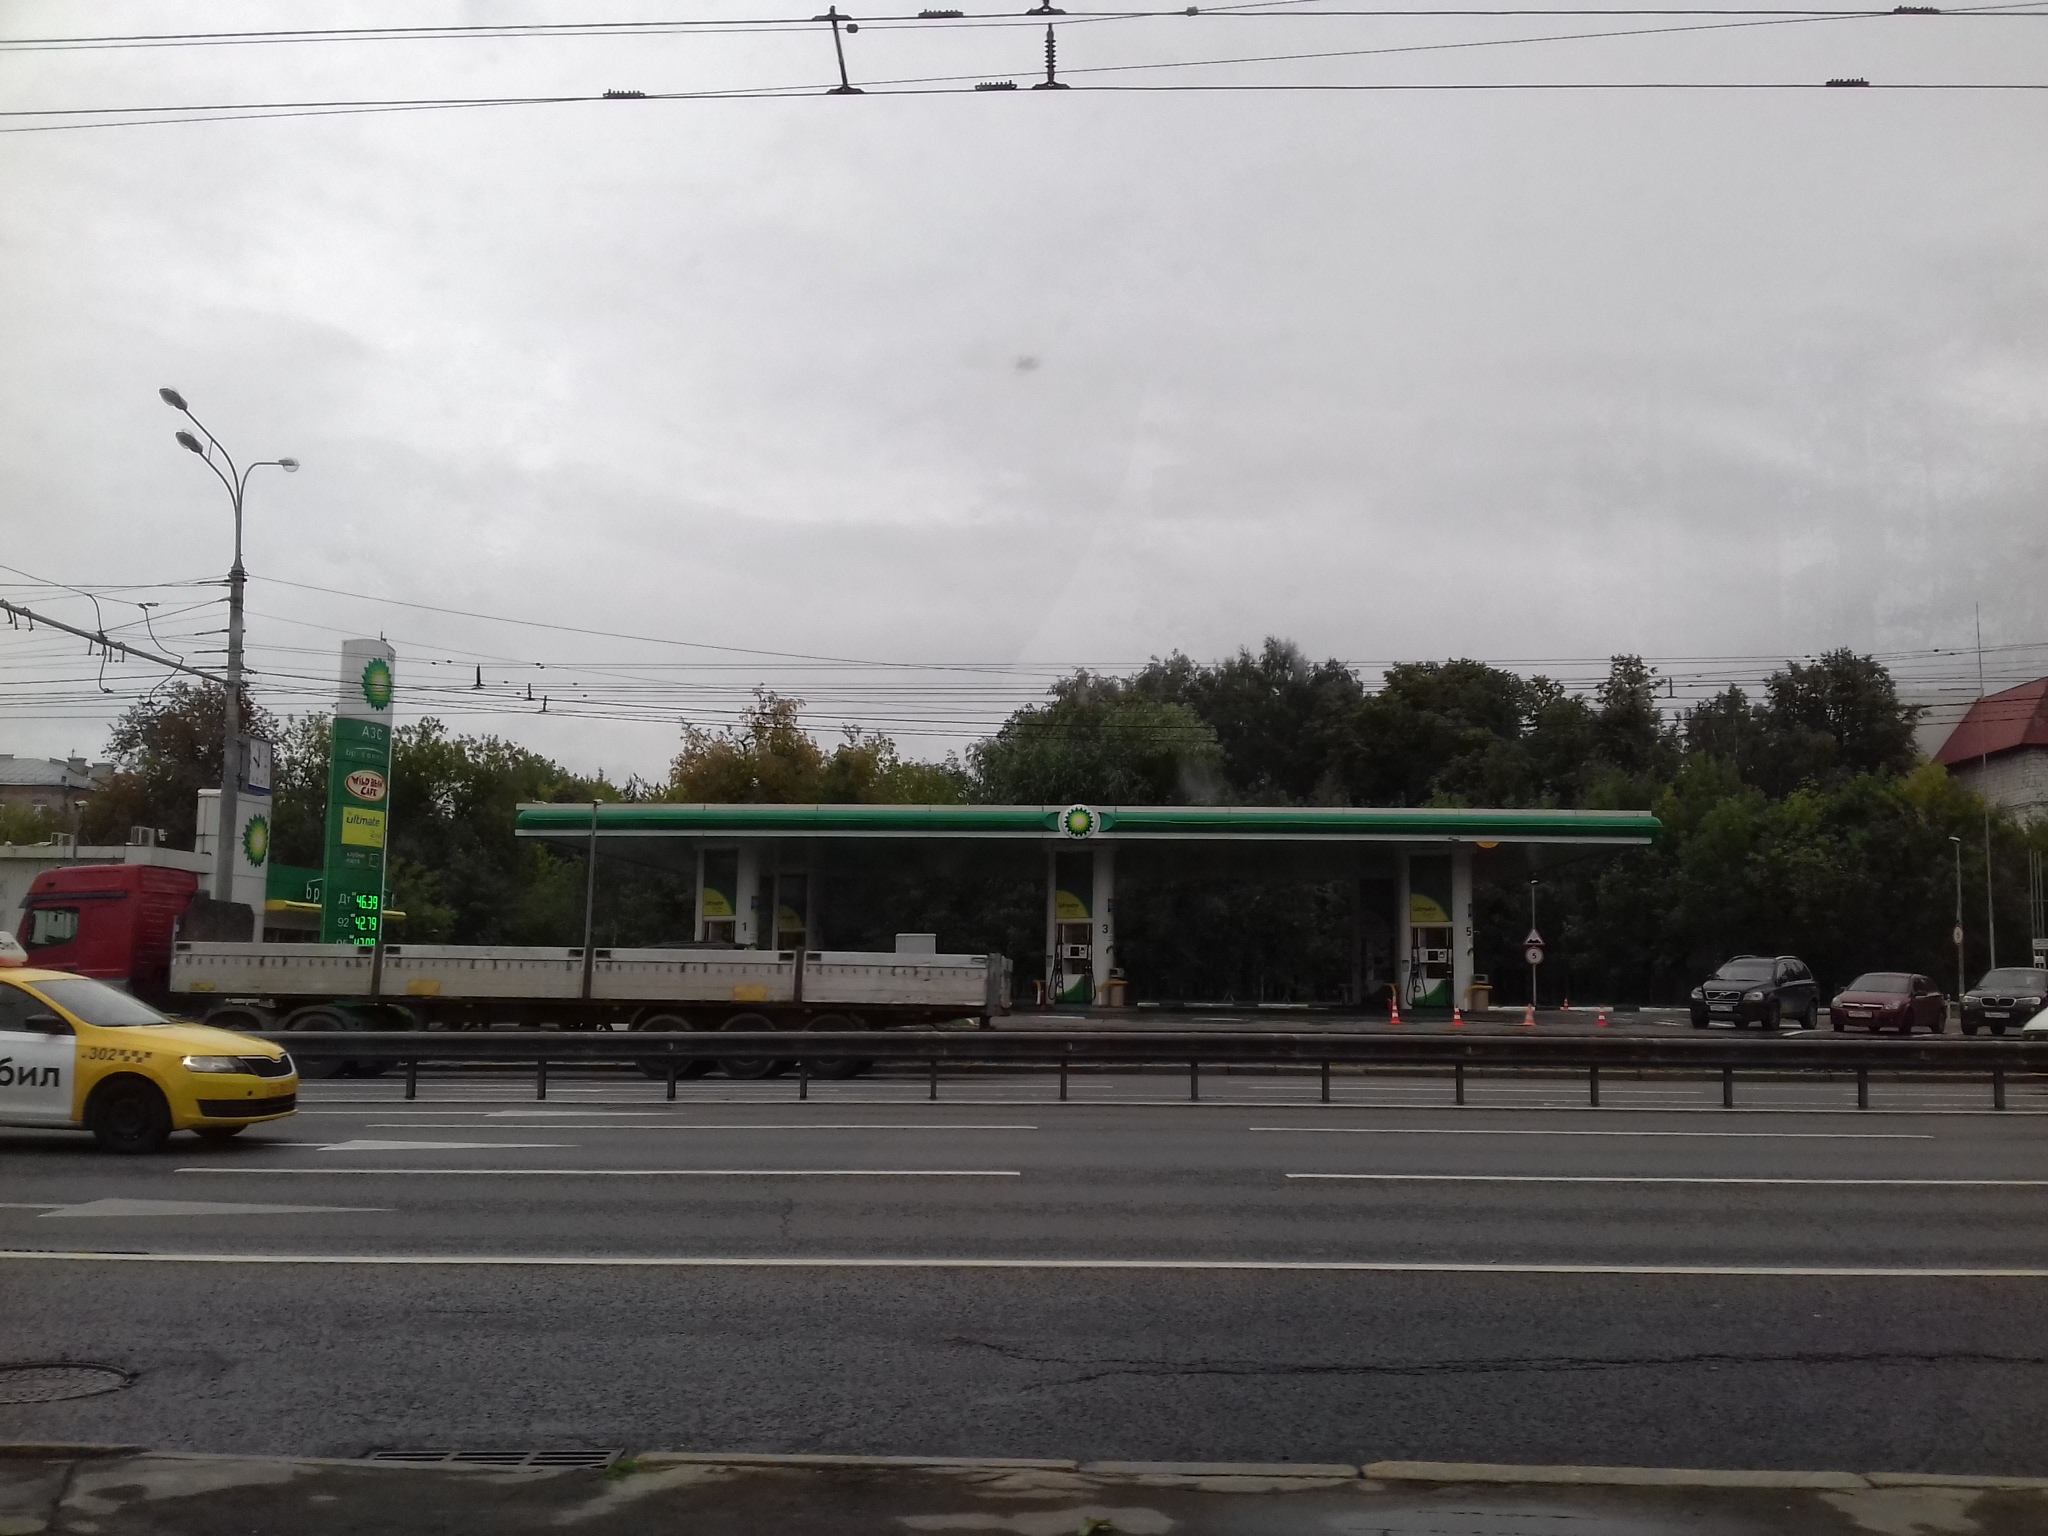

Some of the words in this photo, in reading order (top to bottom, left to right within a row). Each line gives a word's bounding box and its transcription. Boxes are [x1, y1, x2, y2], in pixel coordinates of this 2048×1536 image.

[361, 725, 383, 740] АЗС
[346, 815, 380, 827] ultimate
[337, 917, 349, 928] 92
[742, 922, 747, 932] 1
[1102, 924, 1109, 934] 3
[1466, 926, 1472, 936] 5
[89, 1047, 116, 1061] 302
